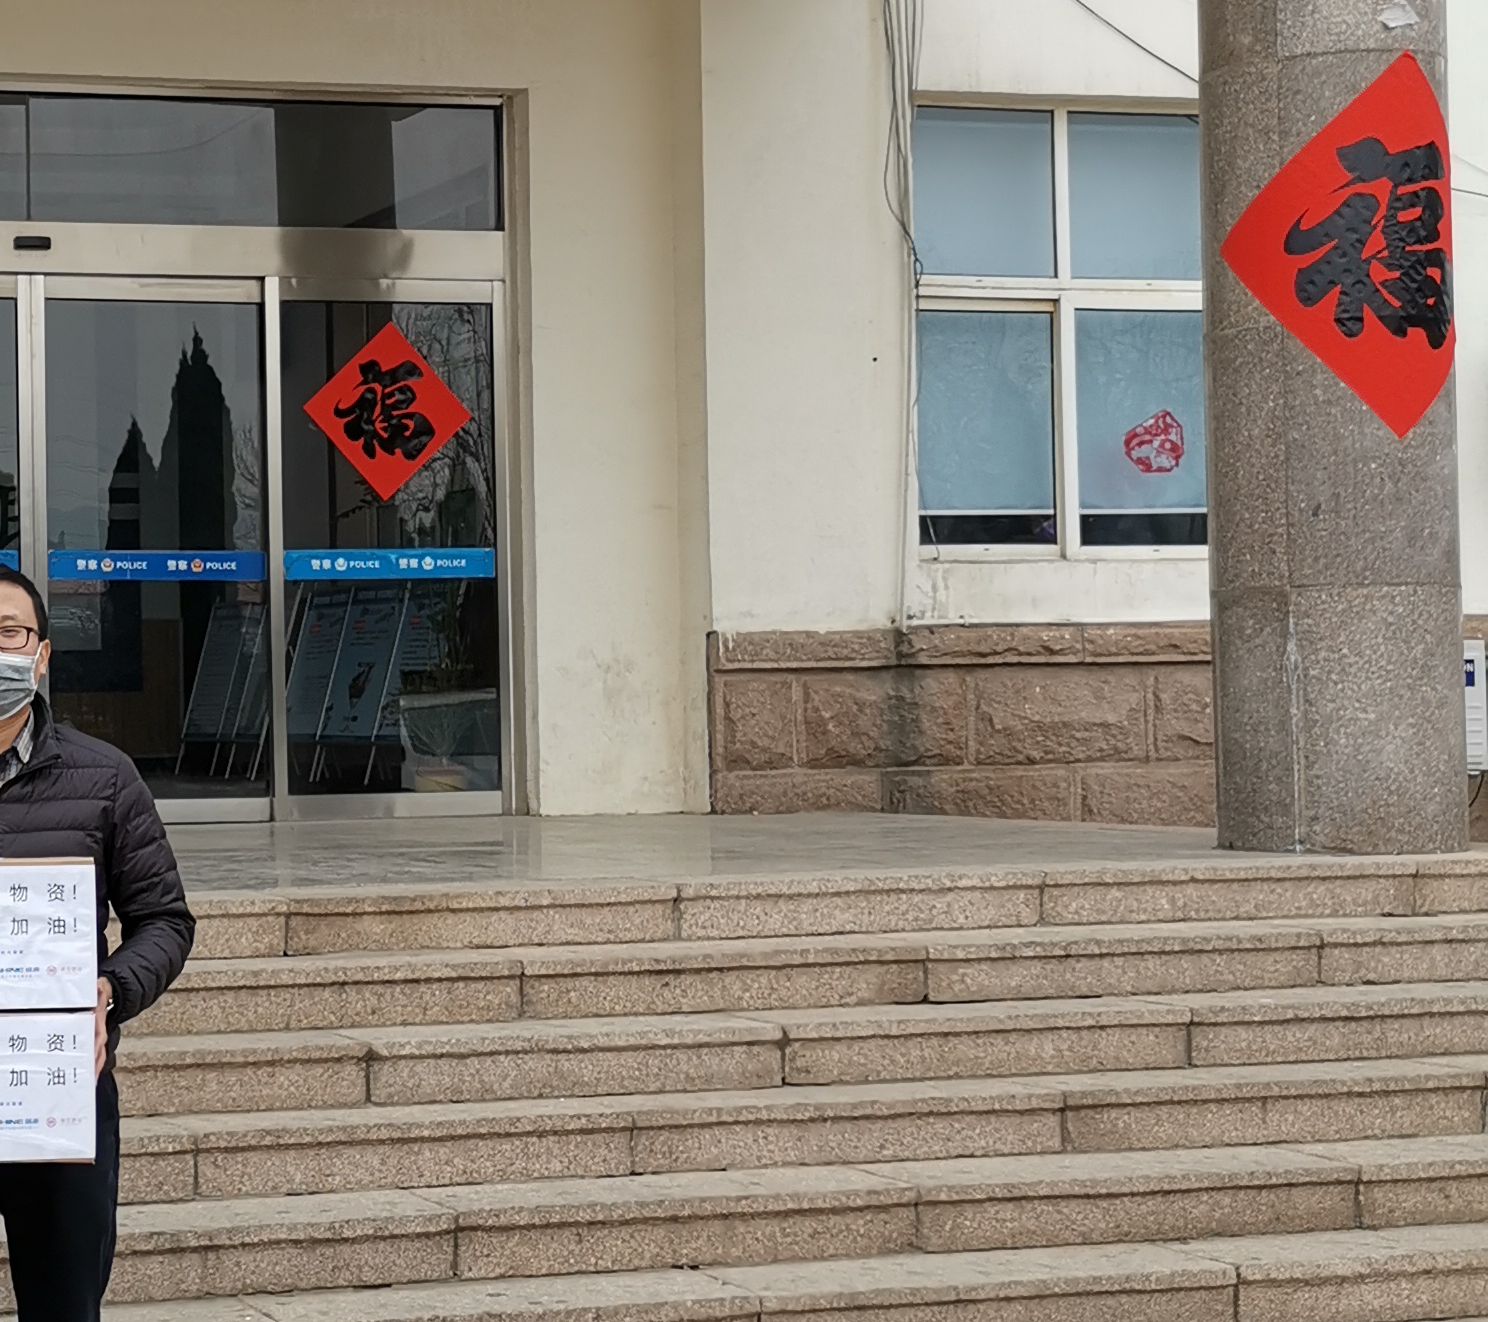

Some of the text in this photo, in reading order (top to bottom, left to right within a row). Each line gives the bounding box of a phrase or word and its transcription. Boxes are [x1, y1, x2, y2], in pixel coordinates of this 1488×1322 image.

[1283, 136, 1452, 350] 福
[333, 359, 436, 461] 福
[116, 561, 147, 570] POLICE
[206, 562, 237, 570] POLICE
[349, 560, 380, 569] POLICE
[436, 559, 467, 567] POLICE
